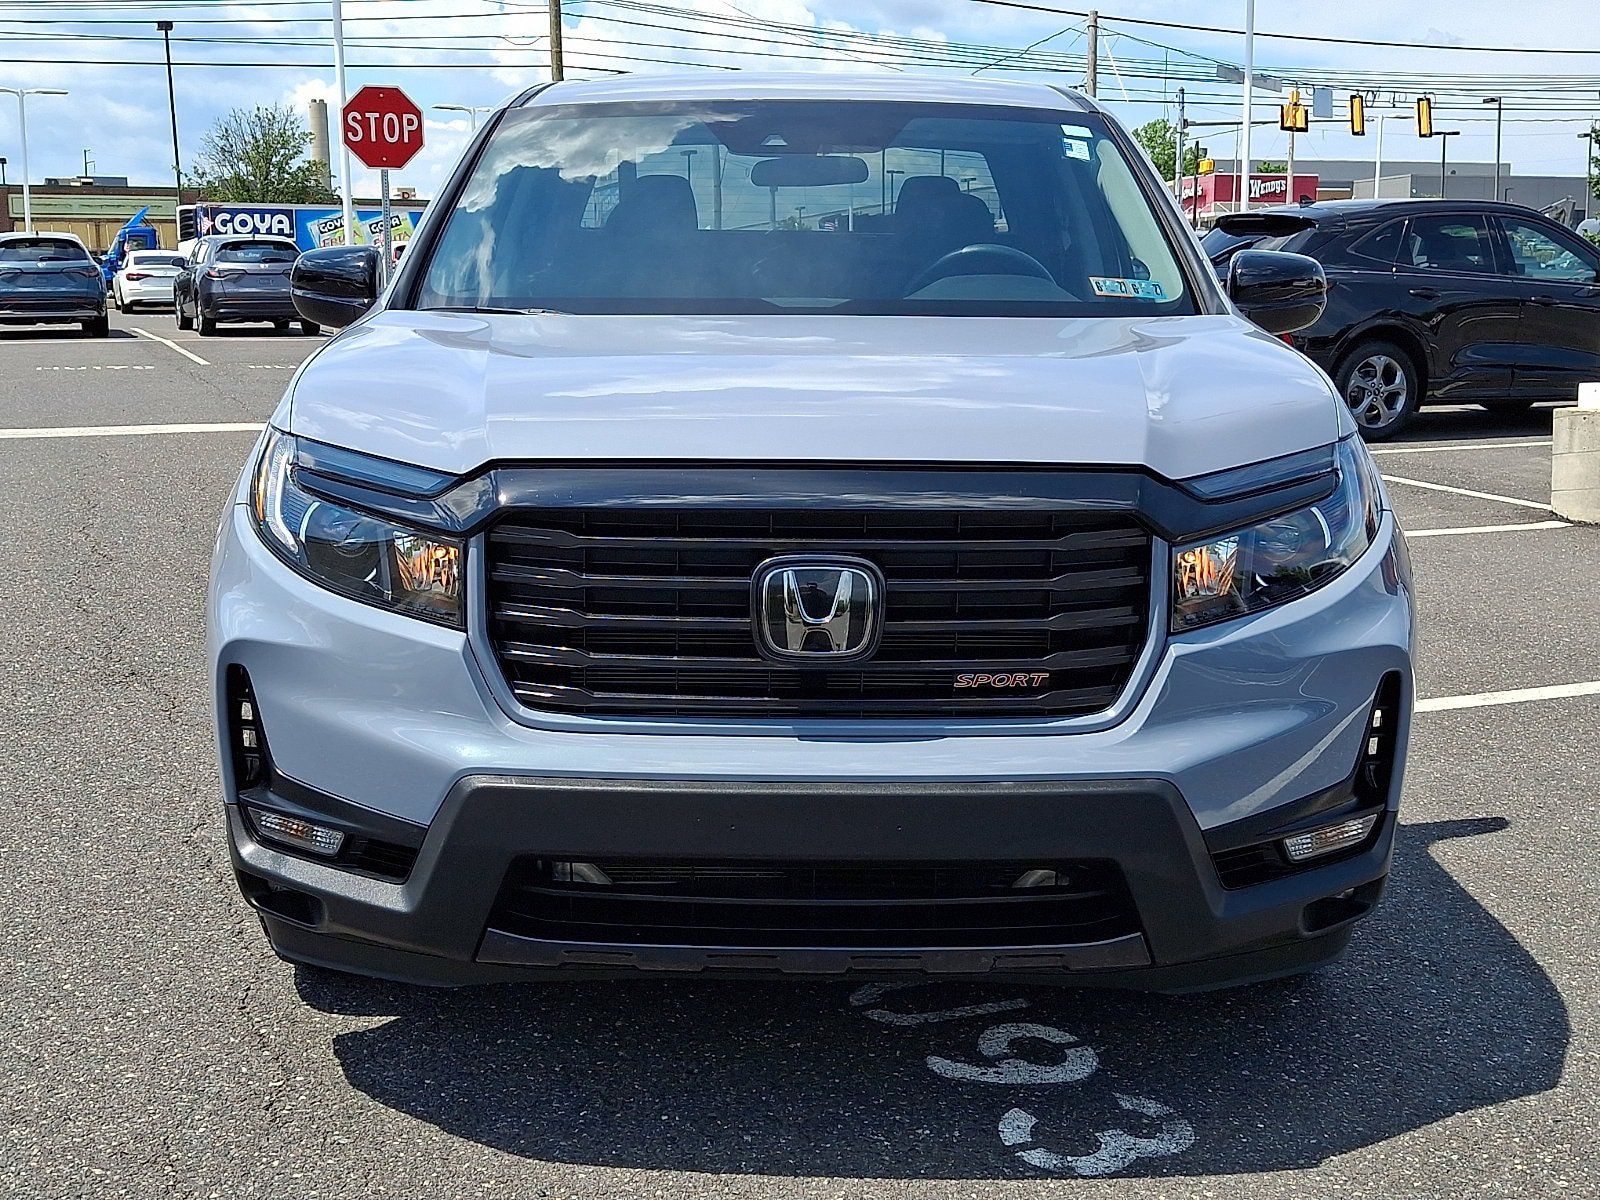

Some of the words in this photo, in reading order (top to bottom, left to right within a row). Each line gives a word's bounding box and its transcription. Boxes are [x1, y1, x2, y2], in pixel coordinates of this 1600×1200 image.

[347, 111, 419, 143] STOP
[214, 212, 290, 235] GOYA
[370, 217, 400, 233] GOA
[953, 673, 1050, 688] SPORT
